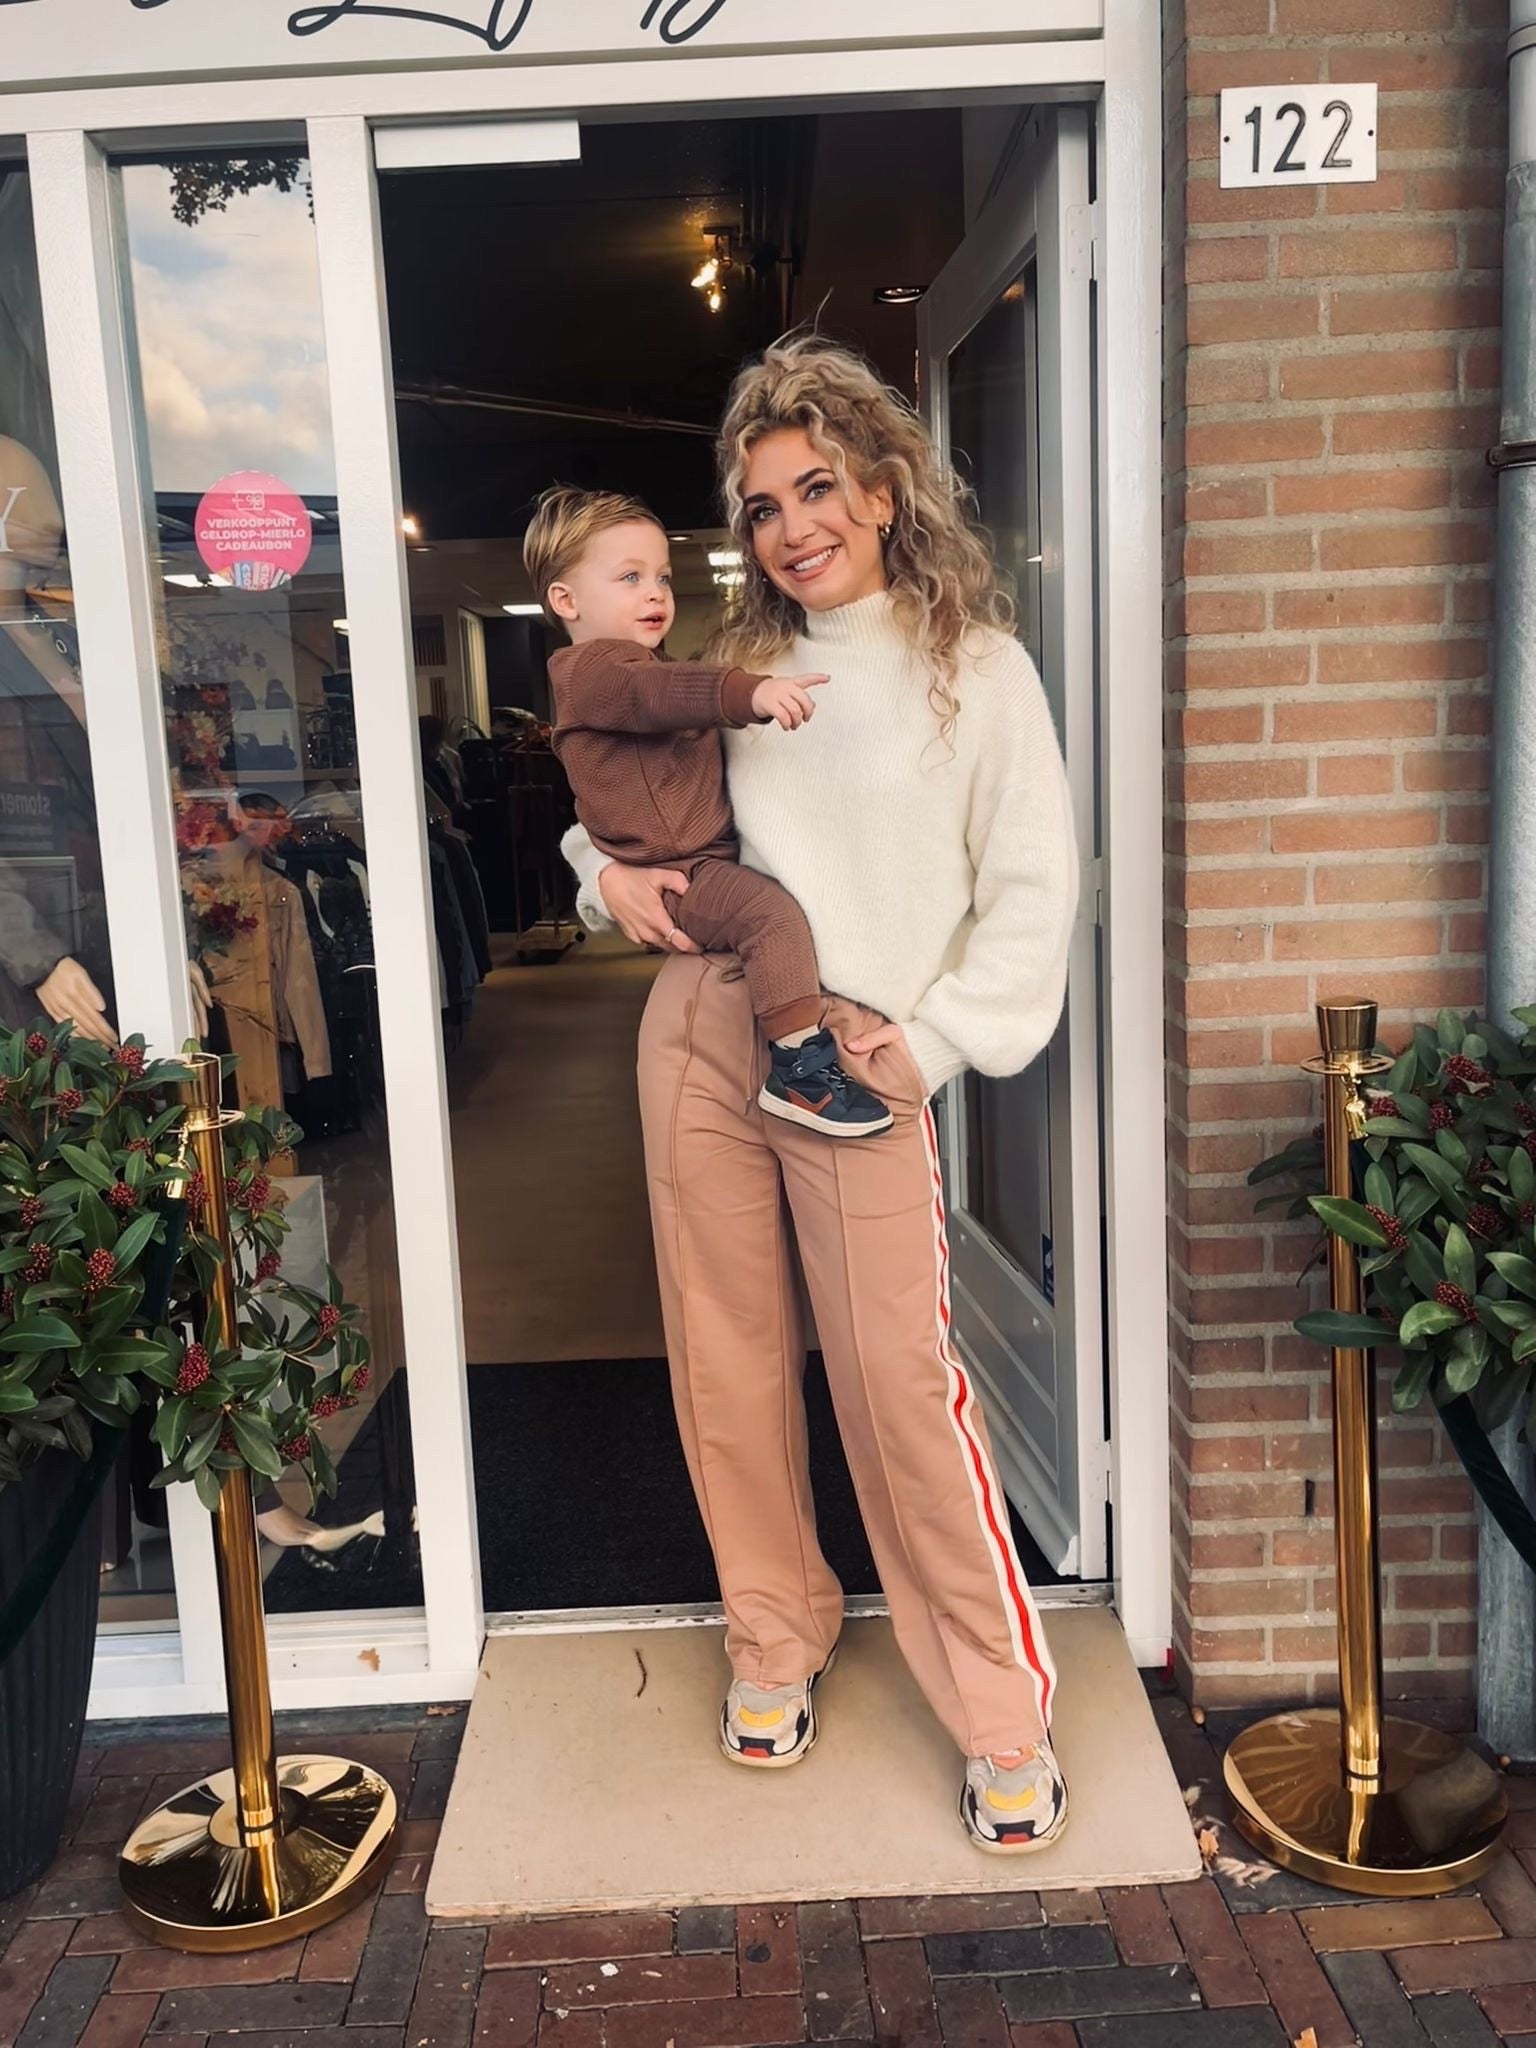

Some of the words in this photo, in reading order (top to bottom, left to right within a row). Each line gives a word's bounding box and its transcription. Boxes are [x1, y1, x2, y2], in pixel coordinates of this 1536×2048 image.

[1245, 100, 1352, 173] 122
[207, 518, 297, 529] VERKOOPPUNT
[200, 528, 305, 540] GELDROP-MIERLO
[216, 540, 292, 551] CADEAUBON
